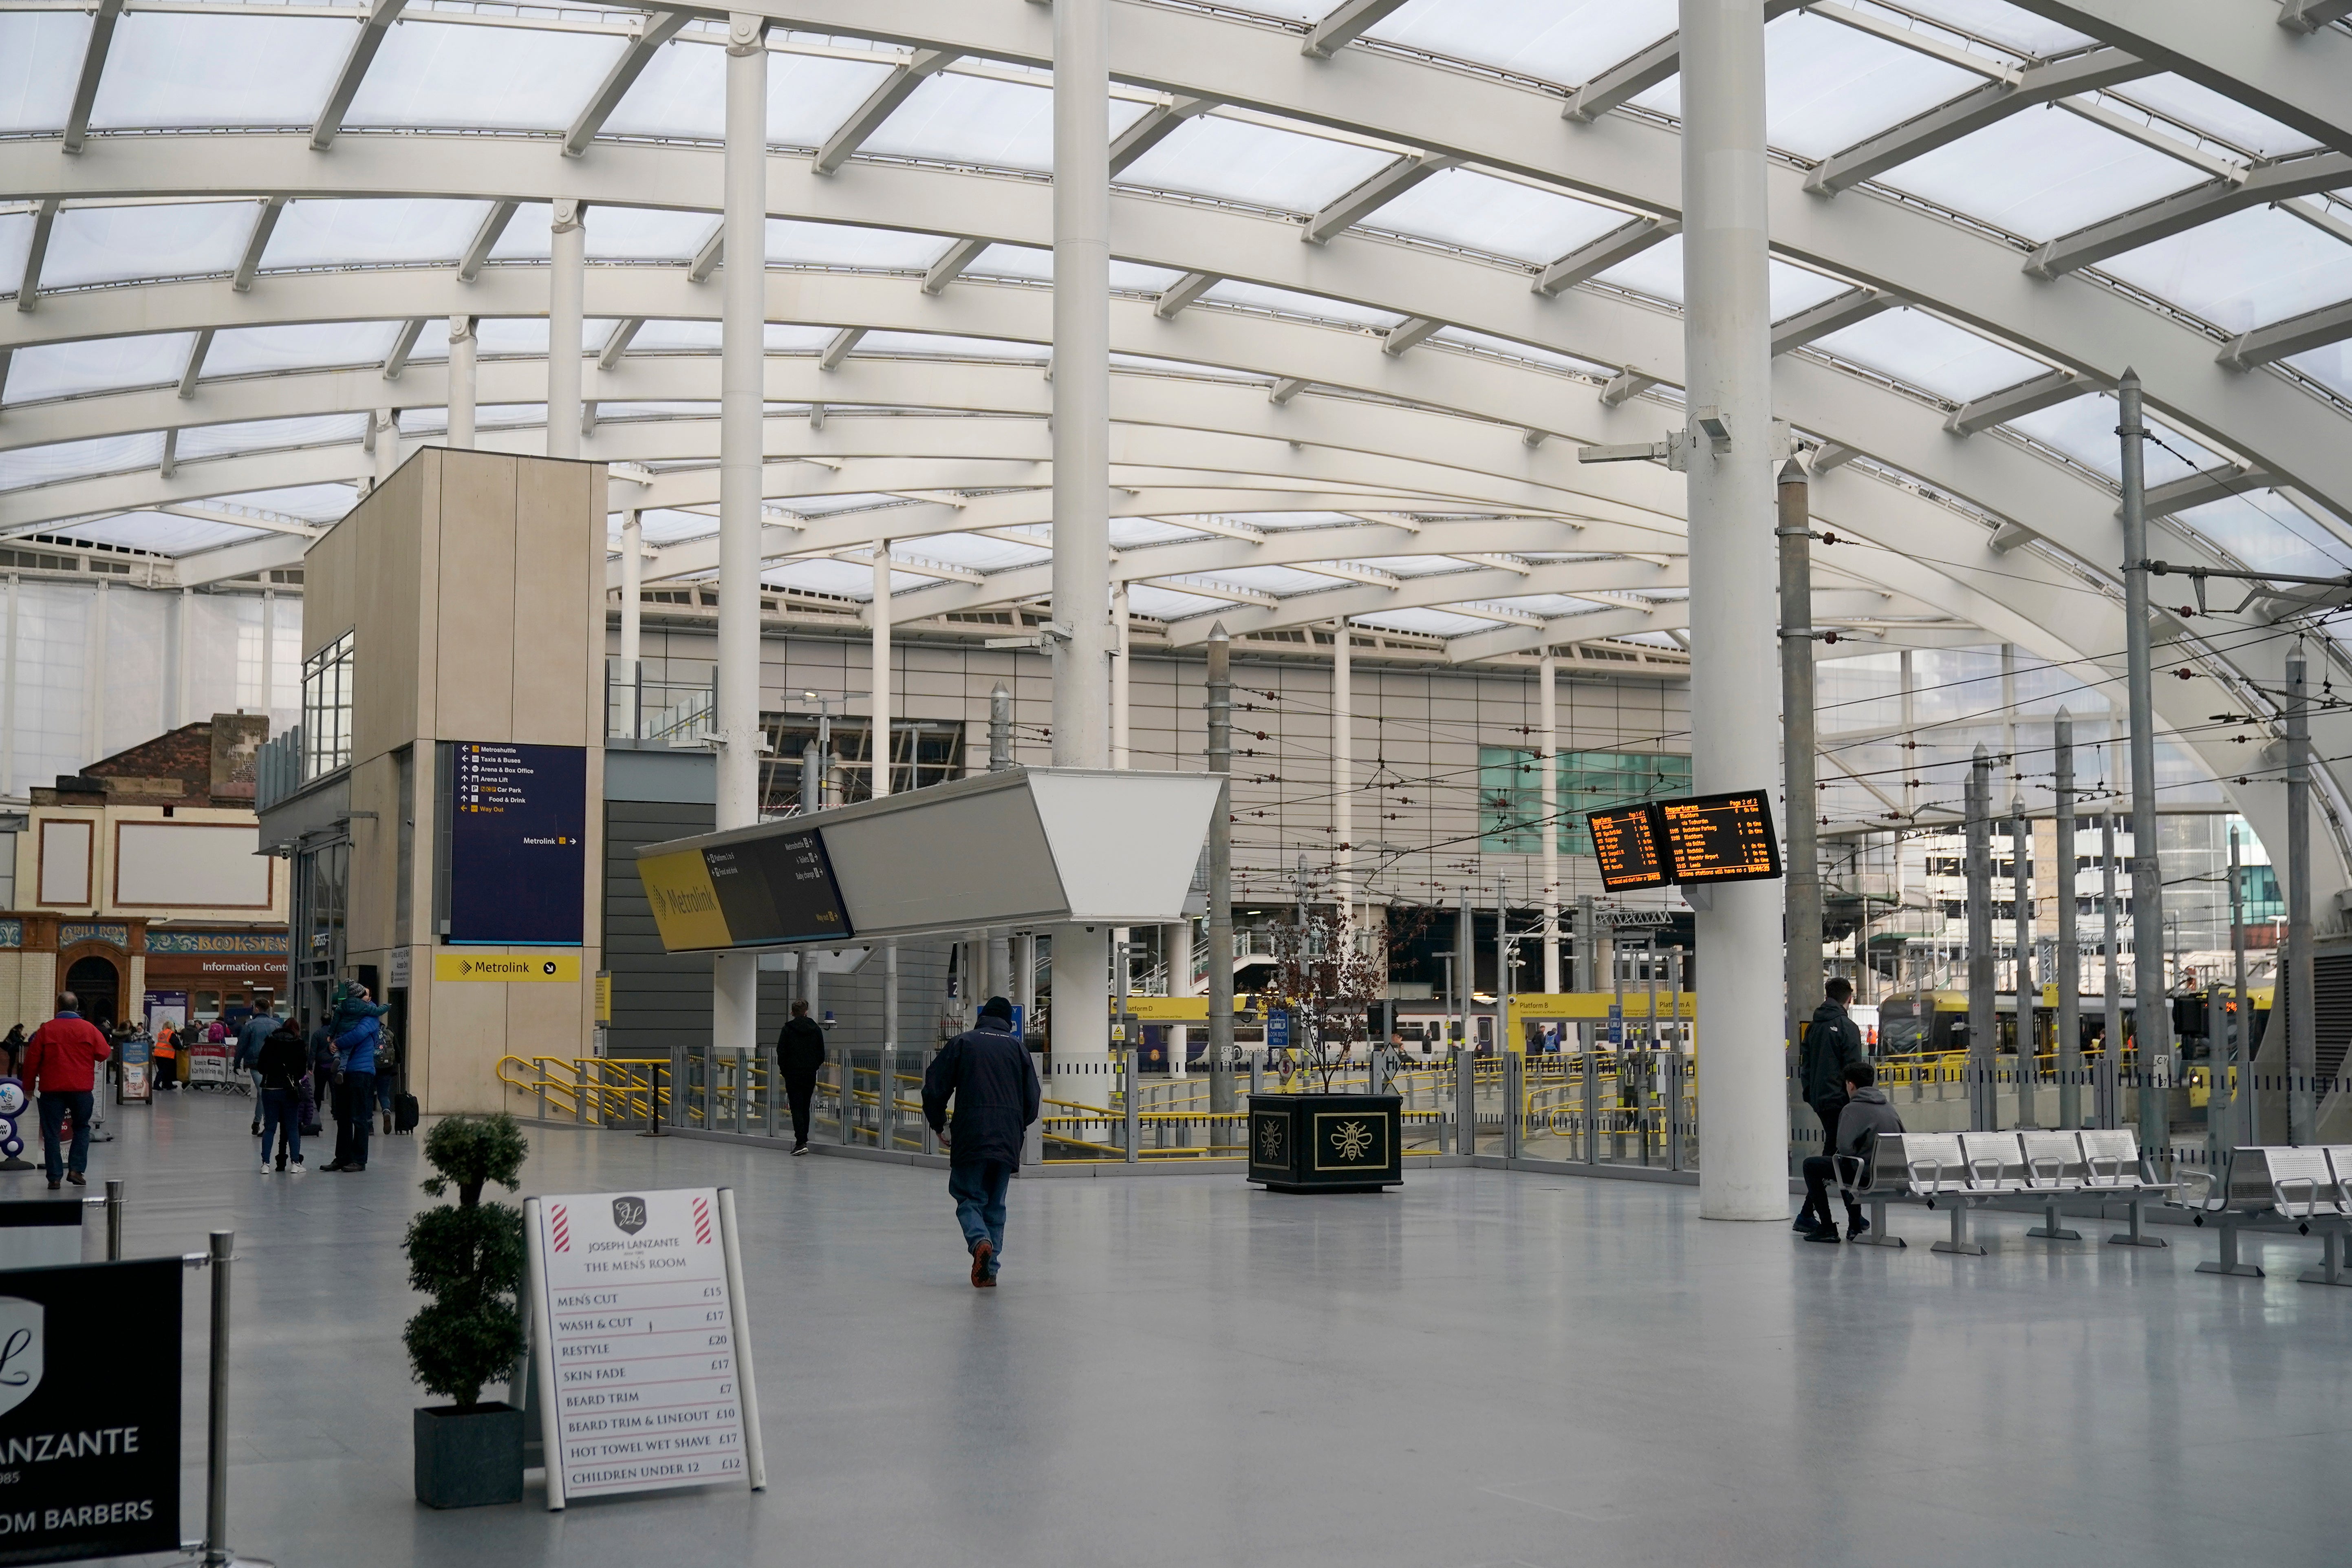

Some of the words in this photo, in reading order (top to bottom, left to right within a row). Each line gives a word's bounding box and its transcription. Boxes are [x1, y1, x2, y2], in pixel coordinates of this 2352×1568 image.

[1665, 805, 1699, 813] Departures
[785, 840, 804, 851] Metroshuttle
[798, 856, 810, 864] Toilets
[796, 872, 804, 881] Baby
[803, 871, 815, 880] change
[667, 884, 716, 914] Metrolink
[62, 926, 95, 941] GRILL
[203, 962, 260, 972] Information
[476, 962, 529, 973] Metrolink
[1283, 1061, 1290, 1074] 5
[589, 1241, 624, 1254] JOSEPH
[627, 1237, 680, 1249] LANZANTE
[584, 1262, 609, 1272] THE
[613, 1257, 645, 1271] MEN'S
[650, 1257, 686, 1268] ROOM
[558, 1293, 591, 1307] MEN'S
[594, 1294, 618, 1304] CUT
[704, 1287, 721, 1297] £15
[560, 1319, 594, 1331] WASH
[598, 1319, 606, 1329] &
[609, 1317, 633, 1328] CUT
[706, 1311, 724, 1321] £17
[562, 1344, 610, 1357] RESTYLE
[709, 1335, 727, 1345] £20
[564, 1370, 592, 1382] SKIN
[597, 1368, 626, 1378] FADE
[711, 1360, 729, 1370] £17
[567, 1394, 605, 1407] BEARD
[610, 1392, 639, 1403] TRIM
[720, 1384, 732, 1394] £7
[569, 1419, 608, 1433] BEARD
[612, 1417, 641, 1429] TRIM
[645, 1417, 653, 1425] &
[657, 1410, 710, 1424] LINEOUT
[717, 1409, 735, 1420] £10
[571, 1447, 597, 1458] HOT
[601, 1442, 643, 1455] TOWEL
[646, 1440, 671, 1451] WET
[675, 1436, 711, 1447] SHAVE
[719, 1434, 737, 1445] £17
[573, 1469, 637, 1484] CHILDREN
[641, 1464, 685, 1477] UNDER
[688, 1462, 700, 1473] 12
[722, 1459, 740, 1469] £12
[45, 1500, 153, 1530] BARBERS
